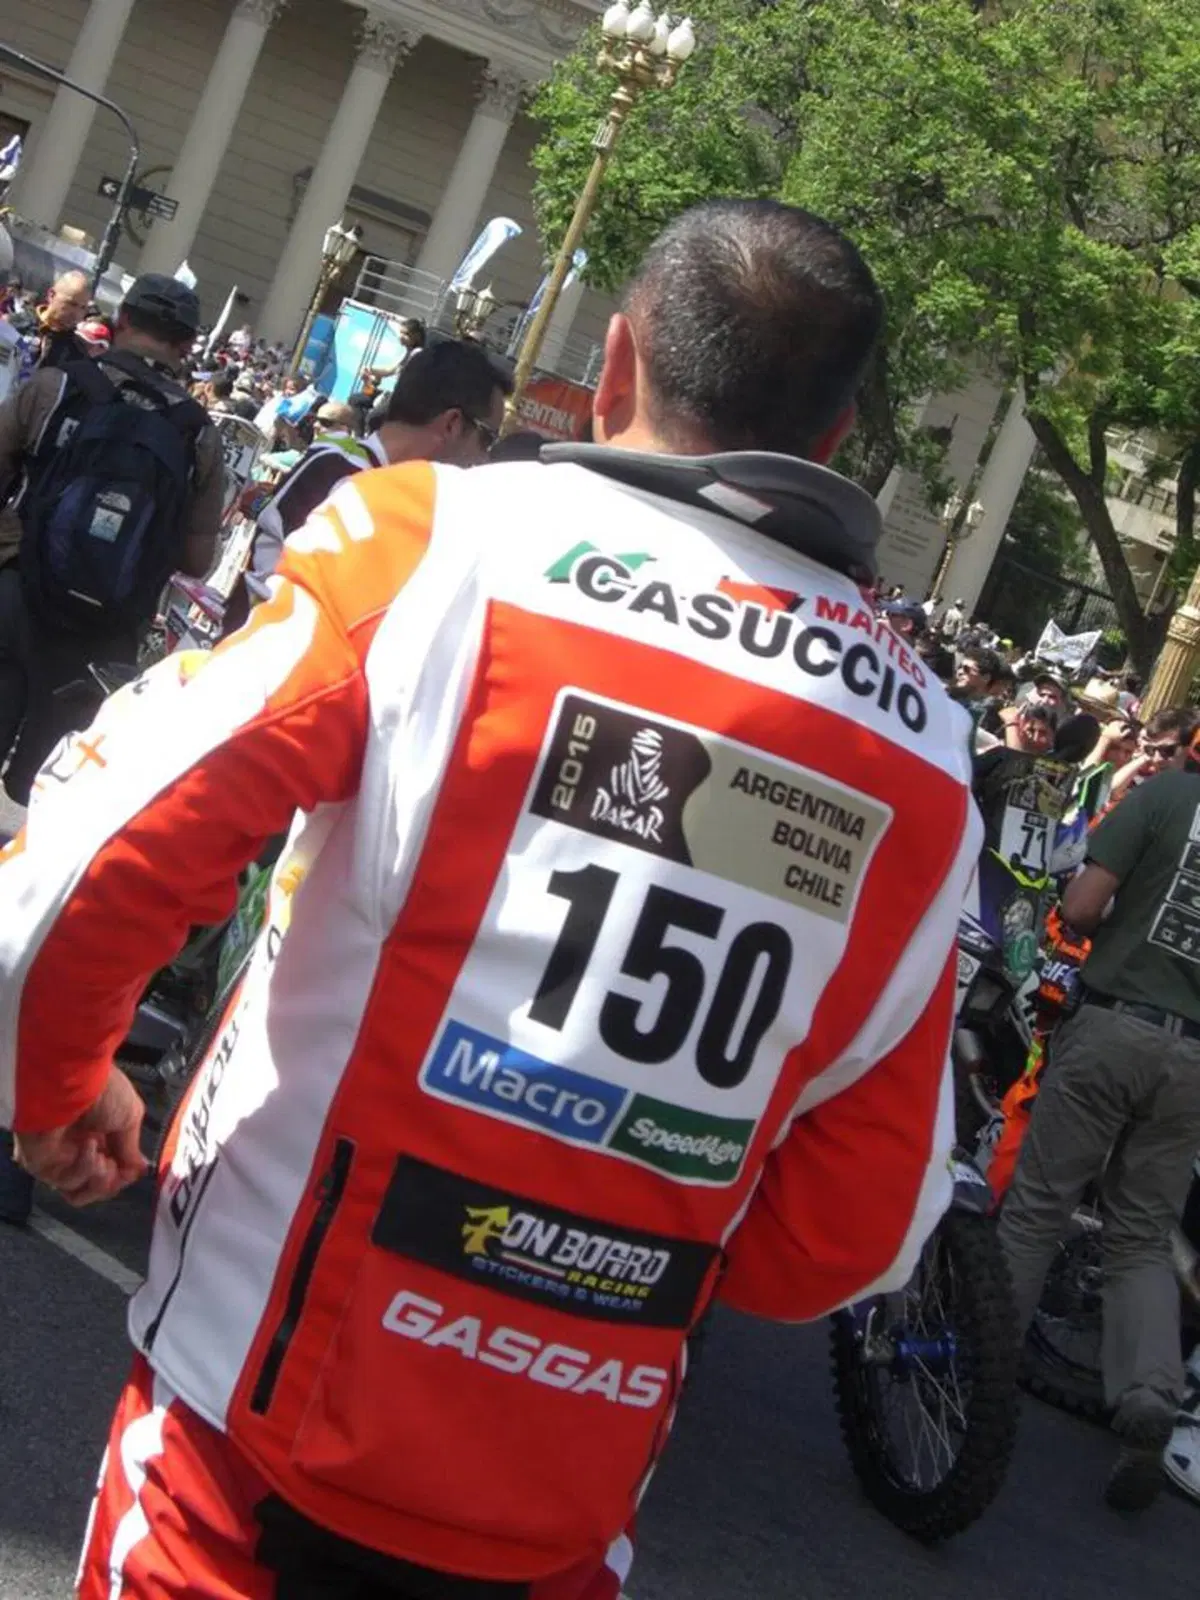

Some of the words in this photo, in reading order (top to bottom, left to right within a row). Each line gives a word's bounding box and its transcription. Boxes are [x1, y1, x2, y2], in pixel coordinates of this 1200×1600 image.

[576, 556, 927, 733] CASUCCIO
[815, 594, 926, 688] MATTEO
[551, 713, 597, 811] 2015
[589, 786, 665, 843] DAKAR
[730, 767, 866, 841] ARGENTINA
[771, 820, 853, 874] BOLIVIA
[1020, 824, 1047, 866] 71
[784, 864, 846, 907] CHILE
[526, 863, 793, 1089] 150
[443, 1037, 606, 1137] Macro
[471, 1256, 571, 1297] STICKERS
[592, 1292, 644, 1311] WEAR
[500, 1212, 561, 1257] ON
[551, 1229, 671, 1284] BOARD
[564, 1270, 651, 1298] RACING
[382, 1289, 668, 1408] GASGAS
